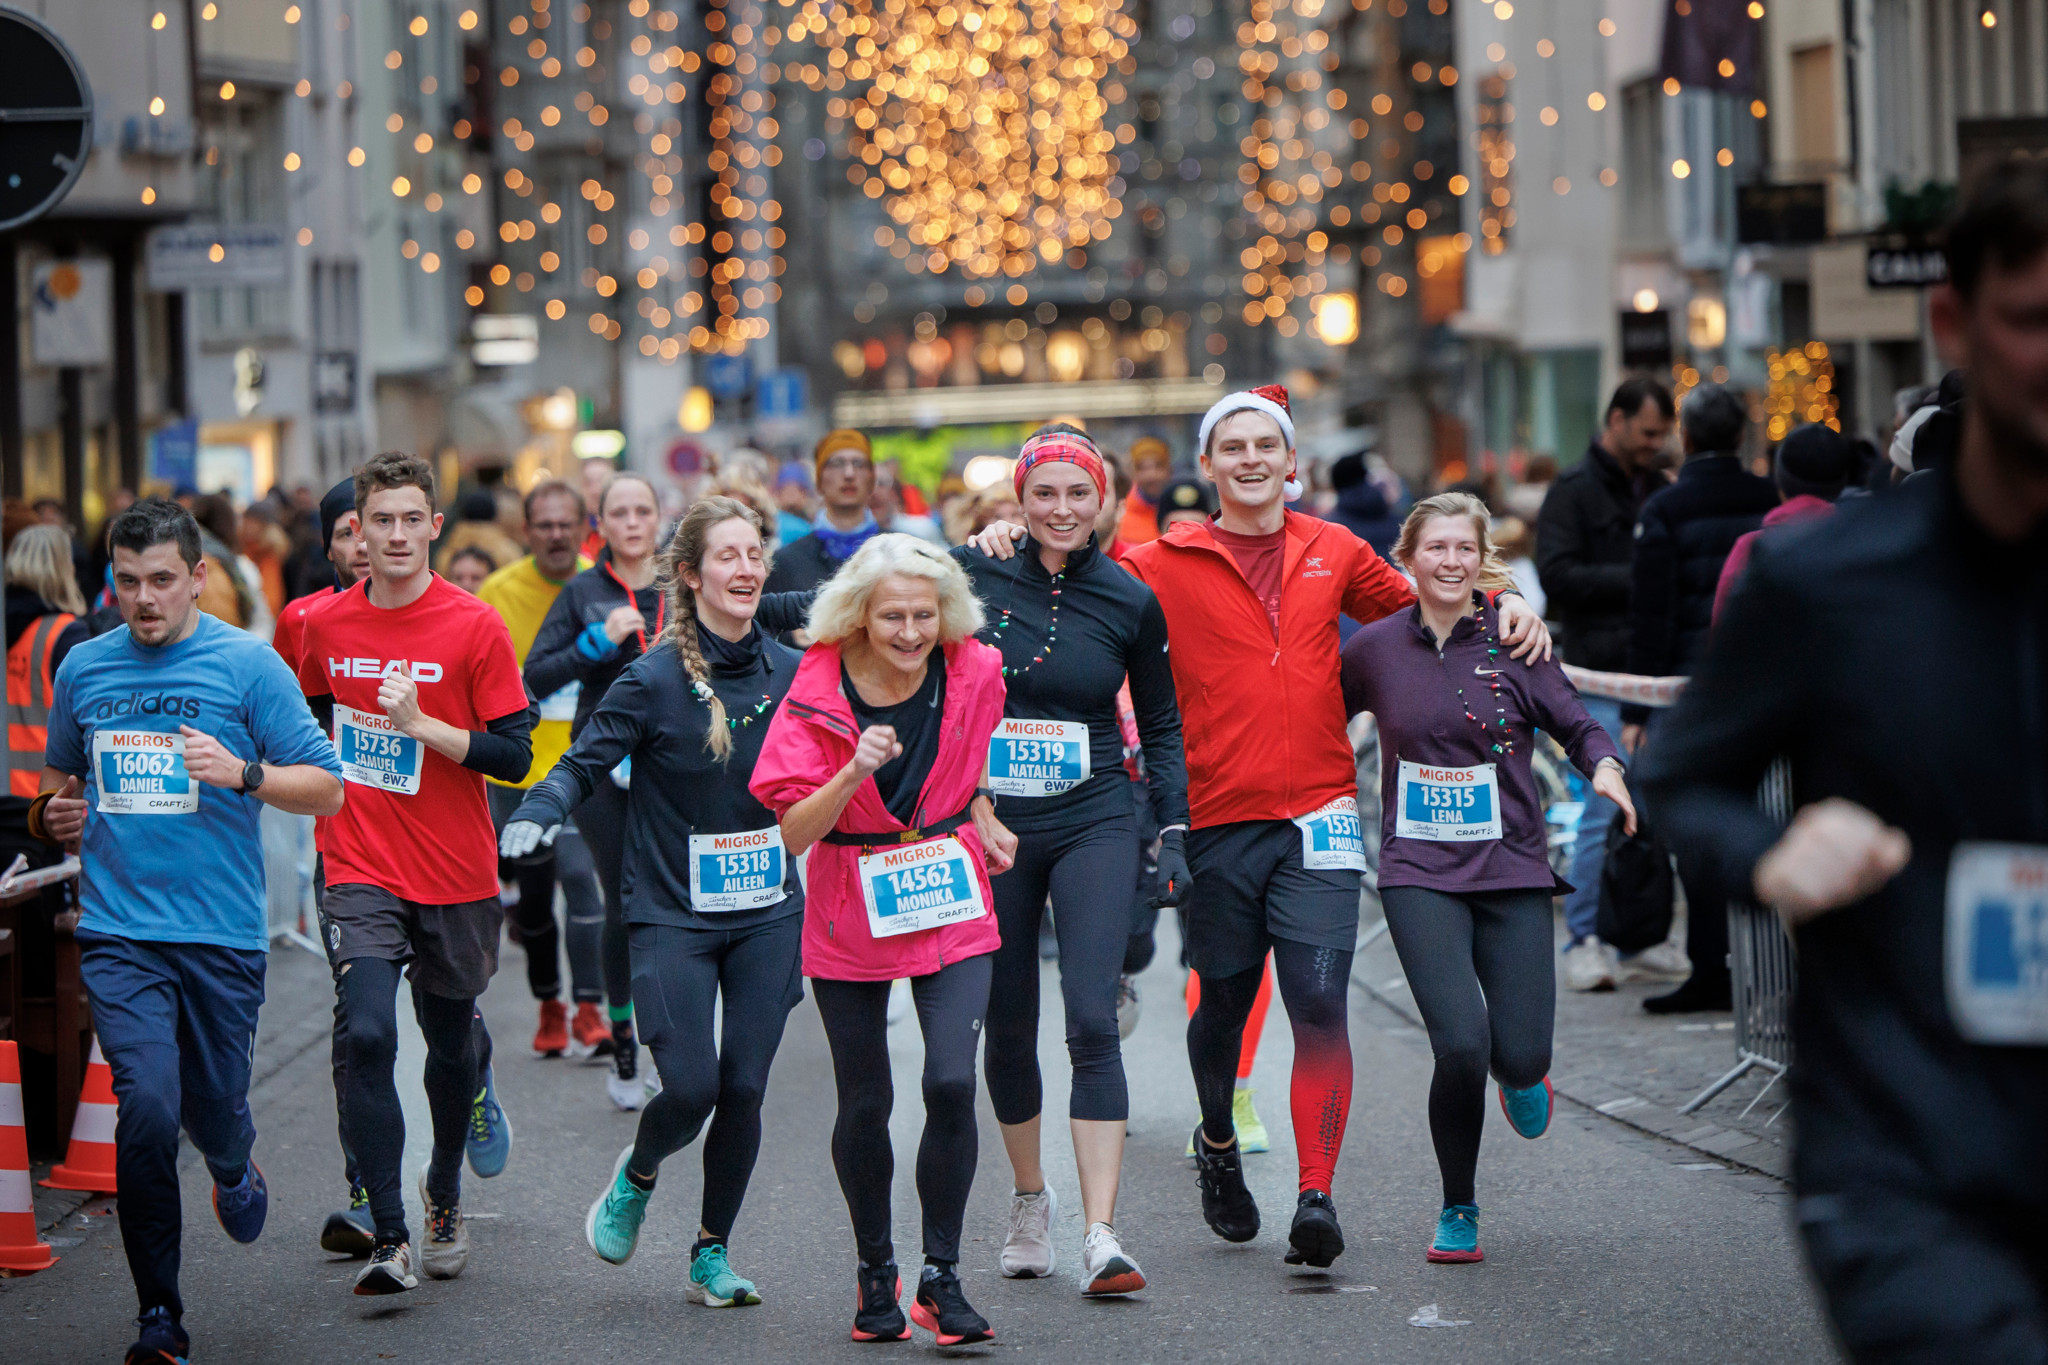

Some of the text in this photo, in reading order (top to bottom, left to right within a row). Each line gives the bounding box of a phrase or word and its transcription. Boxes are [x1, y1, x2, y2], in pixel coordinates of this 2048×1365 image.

[328, 657, 444, 683] HEAD
[96, 692, 200, 721] adidas
[352, 712, 400, 731] MIGRO
[1005, 722, 1064, 736] MIGROS
[113, 734, 174, 748] MIGROS
[352, 729, 402, 757] 15736
[1006, 740, 1065, 763] 15319
[113, 753, 174, 776] 16062
[355, 751, 398, 773] SAMUEL
[1008, 763, 1062, 779] NATALIE
[382, 773, 409, 788] ewz
[1419, 767, 1474, 782] MIGROS
[119, 778, 166, 793] DANIEL
[1044, 780, 1074, 791] ewz
[149, 800, 182, 808] CRAFT
[1421, 785, 1475, 807] 15315
[1431, 809, 1464, 823] LENA
[714, 832, 769, 849] MIGROS
[1455, 828, 1487, 836] CRAFT
[716, 850, 771, 876] 15318
[884, 843, 946, 868] MIGROS
[723, 874, 766, 893] AILEEN
[887, 862, 955, 895] 14562
[896, 887, 955, 914] MONIKA
[937, 907, 969, 920] CRAFT
